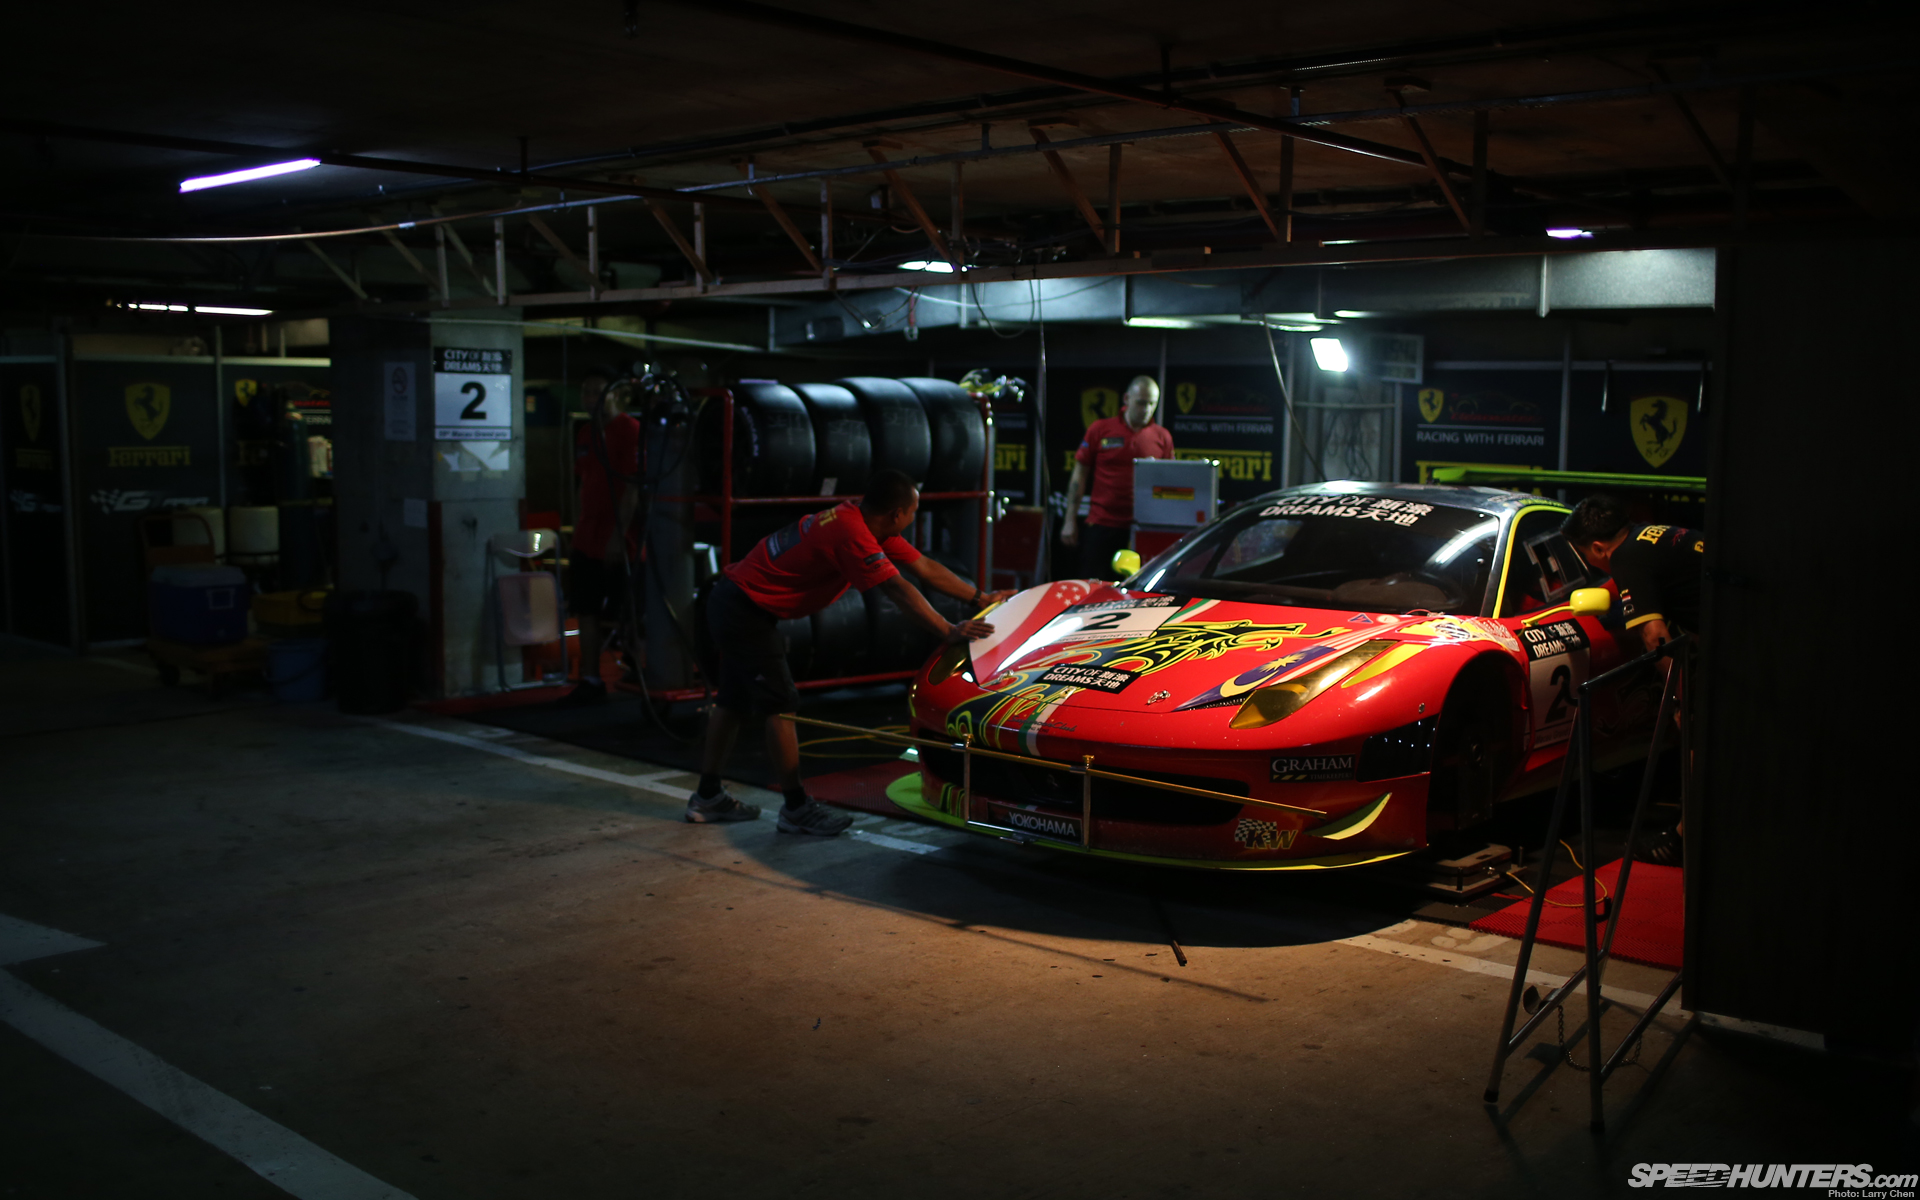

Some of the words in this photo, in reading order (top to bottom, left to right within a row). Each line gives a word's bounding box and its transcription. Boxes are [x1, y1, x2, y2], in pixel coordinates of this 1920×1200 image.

[443, 348, 468, 360] CITY
[443, 360, 481, 371] DREAMS
[461, 381, 486, 420] 2
[1210, 422, 1235, 433] WITH
[1236, 423, 1274, 434] FERRARI
[1416, 431, 1459, 443] RACING
[1464, 432, 1494, 445] WITH
[1497, 434, 1545, 446] FERRARI
[107, 445, 191, 468] Ferrari
[1276, 494, 1341, 506] CITY
[1339, 495, 1375, 506] OF
[1258, 504, 1362, 518] DREAMS
[1355, 507, 1419, 527] 天地
[1077, 612, 1131, 631] 2
[1524, 627, 1547, 643] CITY
[1532, 640, 1566, 658] DREAMS
[1043, 673, 1095, 685] DREAMS
[1053, 666, 1085, 675] CITY
[1083, 668, 1103, 677] OF
[1090, 678, 1121, 689] 天地
[1545, 665, 1571, 724] 2
[1271, 756, 1352, 773] GRAHAM
[1008, 811, 1076, 837] YOKOHAMA
[1244, 829, 1299, 850] KW
